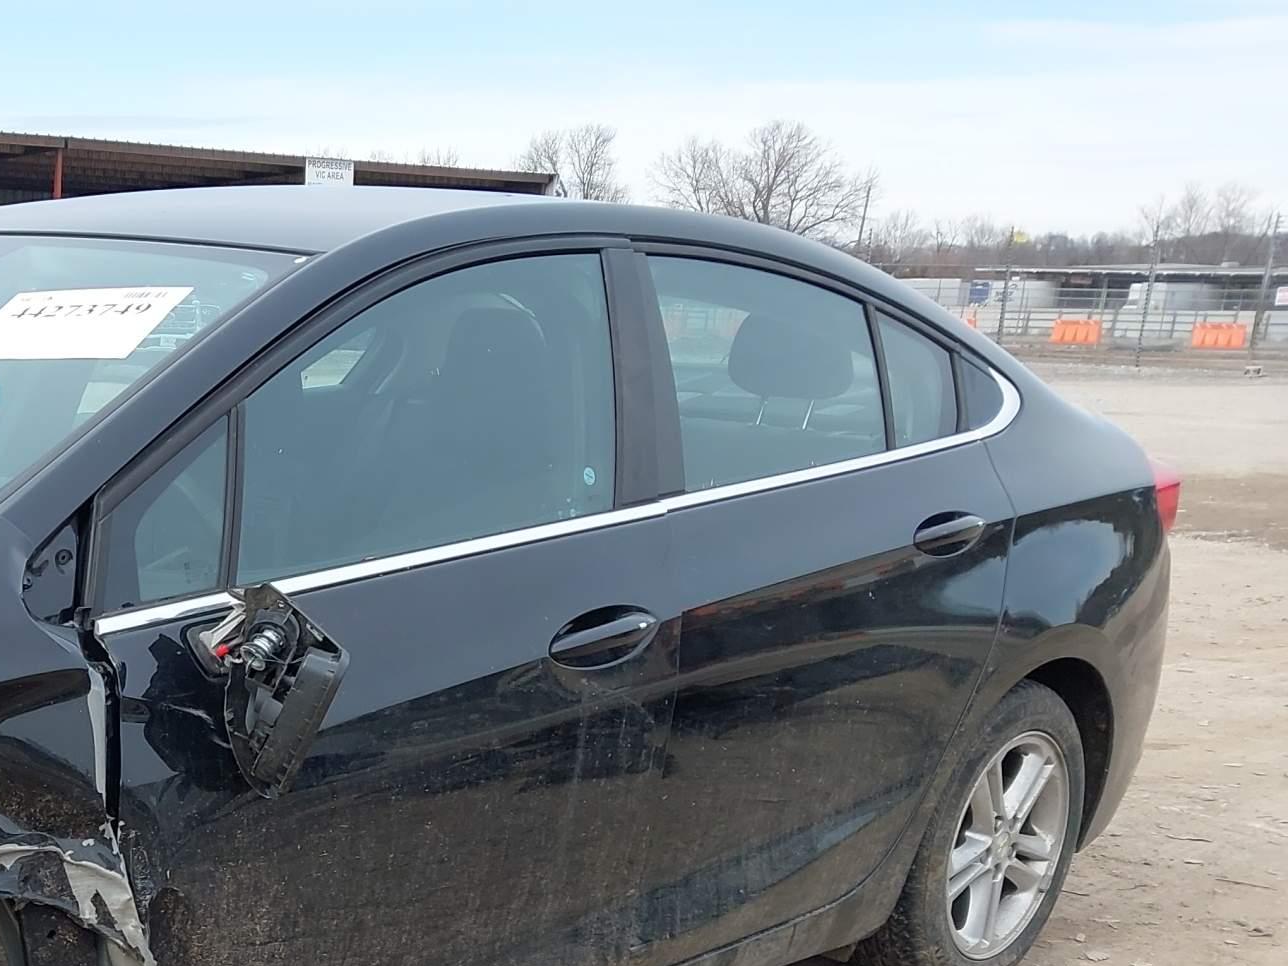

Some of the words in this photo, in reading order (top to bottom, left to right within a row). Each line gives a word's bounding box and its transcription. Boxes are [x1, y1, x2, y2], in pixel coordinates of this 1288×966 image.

[307, 159, 352, 171] PROGRESSIVE
[327, 171, 344, 180] AREA
[11, 302, 152, 318] 44273749
